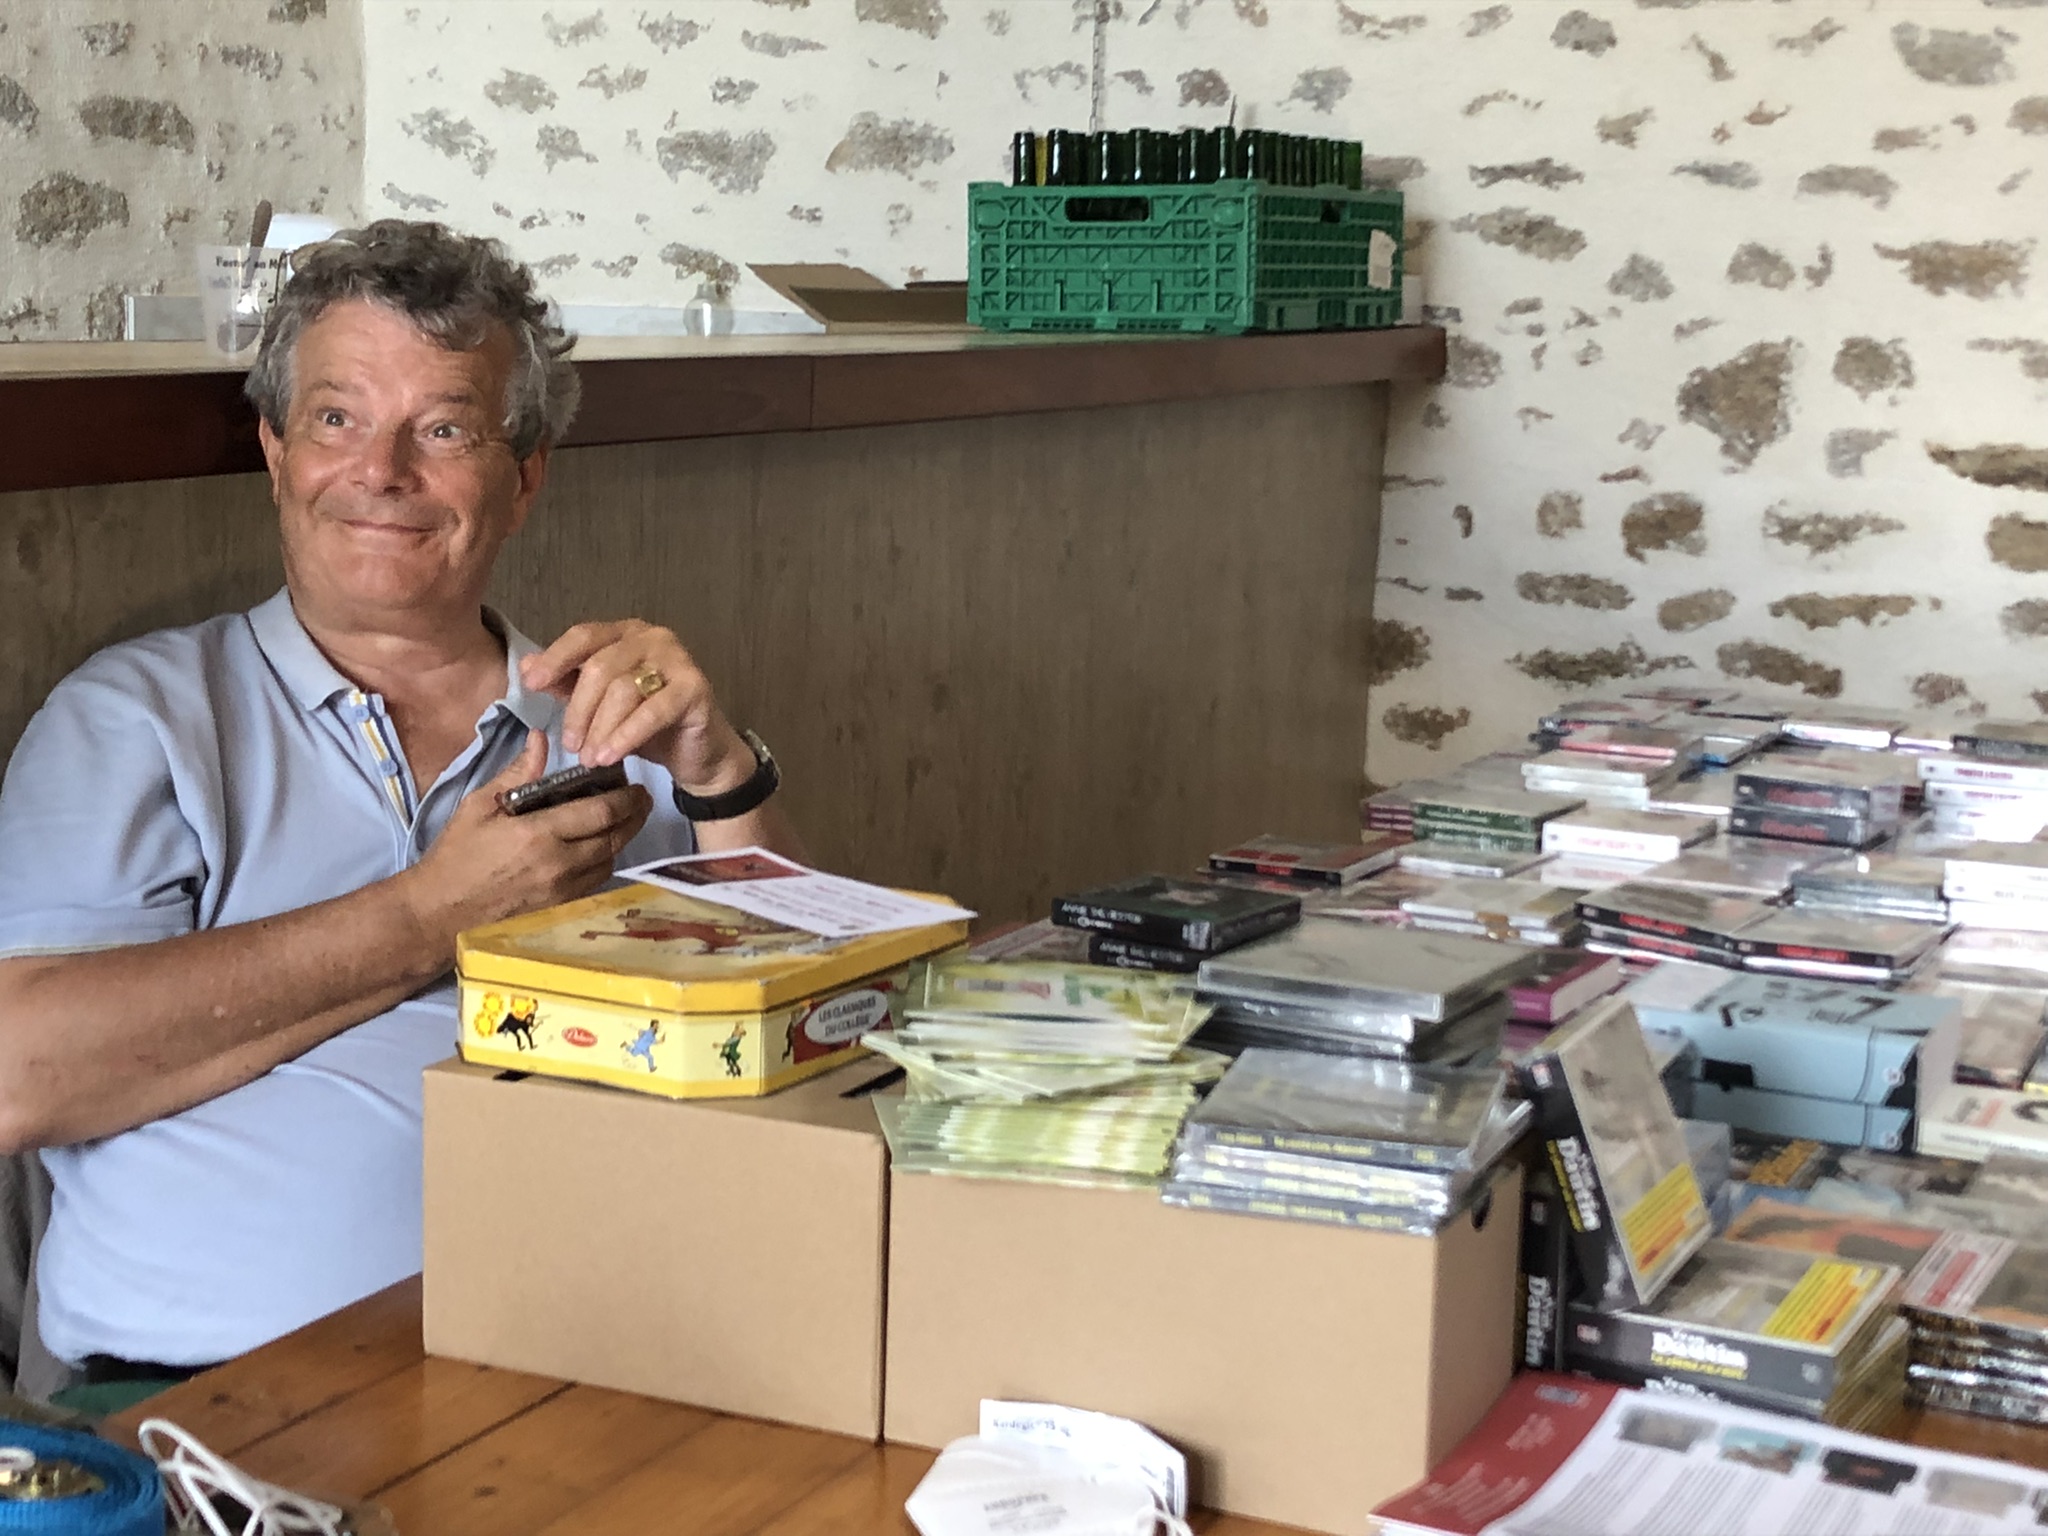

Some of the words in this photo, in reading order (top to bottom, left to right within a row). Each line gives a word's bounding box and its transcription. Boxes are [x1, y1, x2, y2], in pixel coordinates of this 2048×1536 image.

[818, 1008, 832, 1023] LES
[833, 996, 876, 1018] CLASSIQUES
[825, 1023, 837, 1037] DU
[1556, 1136, 1601, 1232] Dautin
[1526, 1275, 1549, 1366] Dautin
[1652, 1331, 1748, 1370] Dautin
